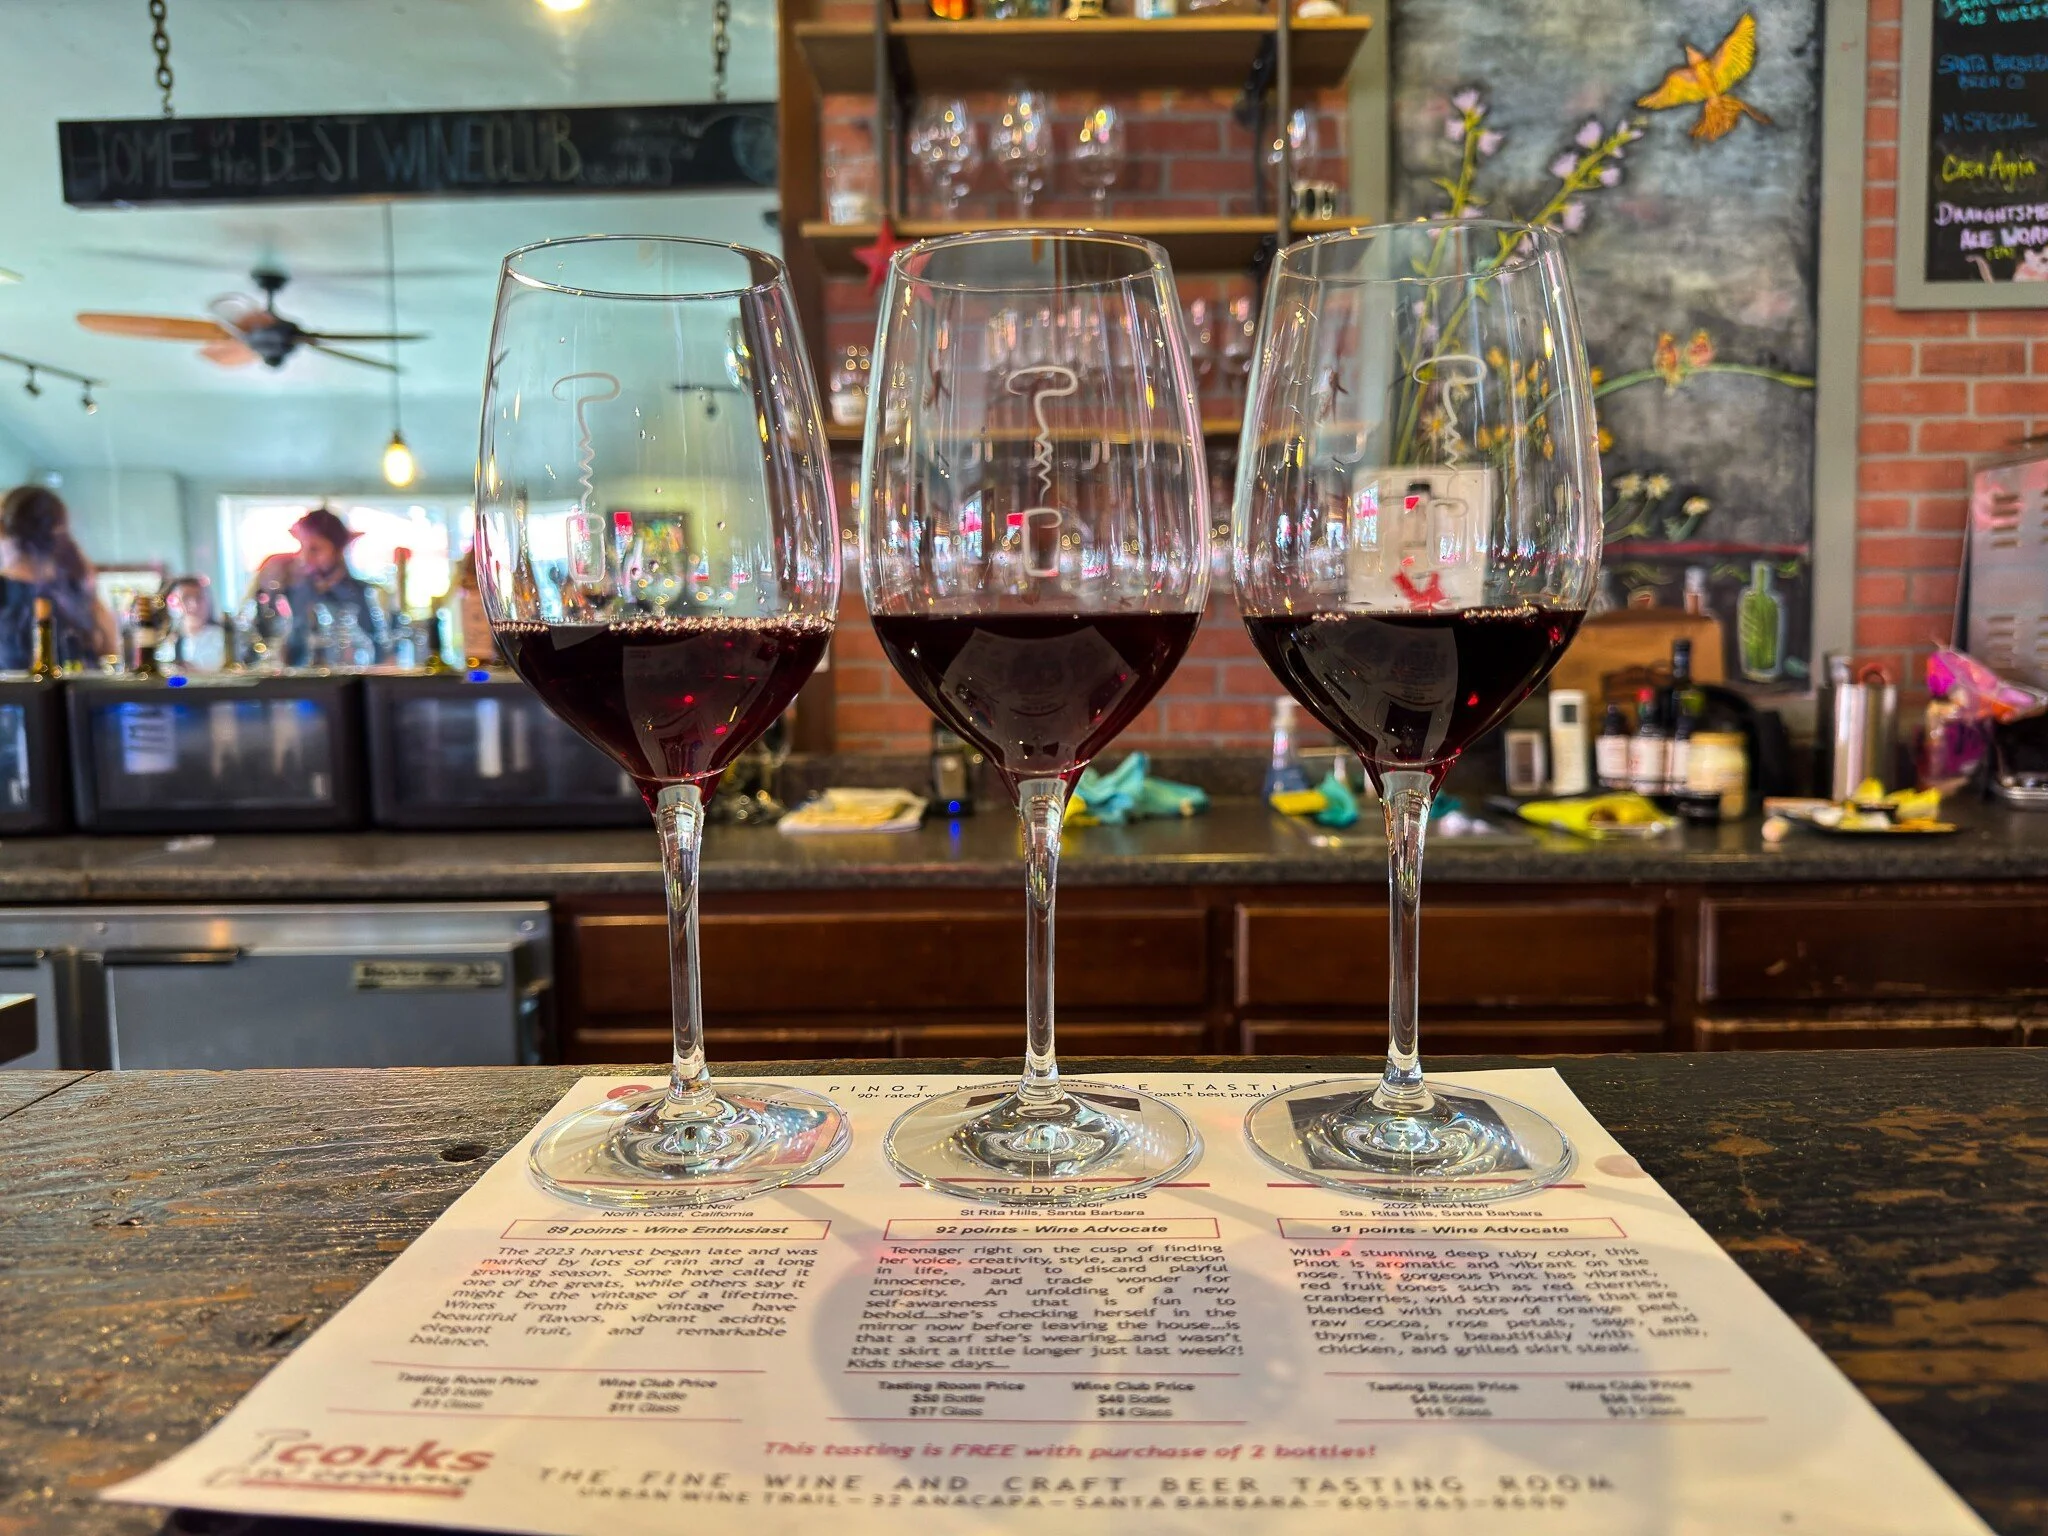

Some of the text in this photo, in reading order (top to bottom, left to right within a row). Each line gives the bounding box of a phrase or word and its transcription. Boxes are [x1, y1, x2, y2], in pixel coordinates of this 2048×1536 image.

[262, 116, 368, 183] BEST
[1031, 1185, 1056, 1195] by
[1382, 1201, 1489, 1209] 2022 Pinot Noir
[643, 1210, 685, 1219] Coast,
[690, 1210, 754, 1218] California
[1009, 1208, 1042, 1217] Hills,
[1046, 1208, 1086, 1216] Santa
[546, 1225, 569, 1234] 89
[569, 1226, 628, 1236] points
[644, 1226, 688, 1234] Wine
[691, 1225, 789, 1234] Enthusiast
[935, 1226, 958, 1234] 92
[959, 1225, 1017, 1236] points
[1035, 1225, 1079, 1233] Wine
[1082, 1225, 1168, 1233] Advocate
[1331, 1225, 1351, 1233] 91
[1358, 1226, 1416, 1235] points
[1432, 1226, 1478, 1234] Wine
[1483, 1225, 1569, 1234] Advocate
[498, 1247, 529, 1255] The
[534, 1247, 575, 1255] 2023
[580, 1247, 644, 1256] harvest
[649, 1247, 701, 1257] began
[707, 1247, 742, 1255] late
[747, 1247, 780, 1255] and
[890, 1246, 964, 1256] Teenager
[973, 1246, 1013, 1256] right
[1053, 1245, 1080, 1254] the
[1089, 1246, 1128, 1254] cusp
[1136, 1244, 1154, 1253] of
[1163, 1244, 1223, 1255] finding
[1289, 1247, 1639, 1258] With a stunning deep ruby color, this
[481, 1257, 815, 1269] marked by lots of rain and a long
[878, 1252, 1226, 1267] her voice, creativity, style, and direction
[1292, 1256, 1649, 1269] Pinot is aromatic and vibrant on the
[472, 1267, 810, 1278] growing season. Some have called it
[876, 1263, 1228, 1276] in life, about to discard playful
[462, 1278, 806, 1290] one of the greats, while others say it
[878, 1380, 1025, 1393] Tasting Room Price
[1071, 1381, 1195, 1392] Wine Club Price
[276, 1440, 495, 1472] corks
[765, 1441, 1376, 1460] This tasting is FREE with purchase of 2 bottles!
[539, 1467, 1617, 1493] THE FINE WINE AND CRAFT BEER TASTING ROOM
[1074, 1494, 1167, 1508] SANTA
